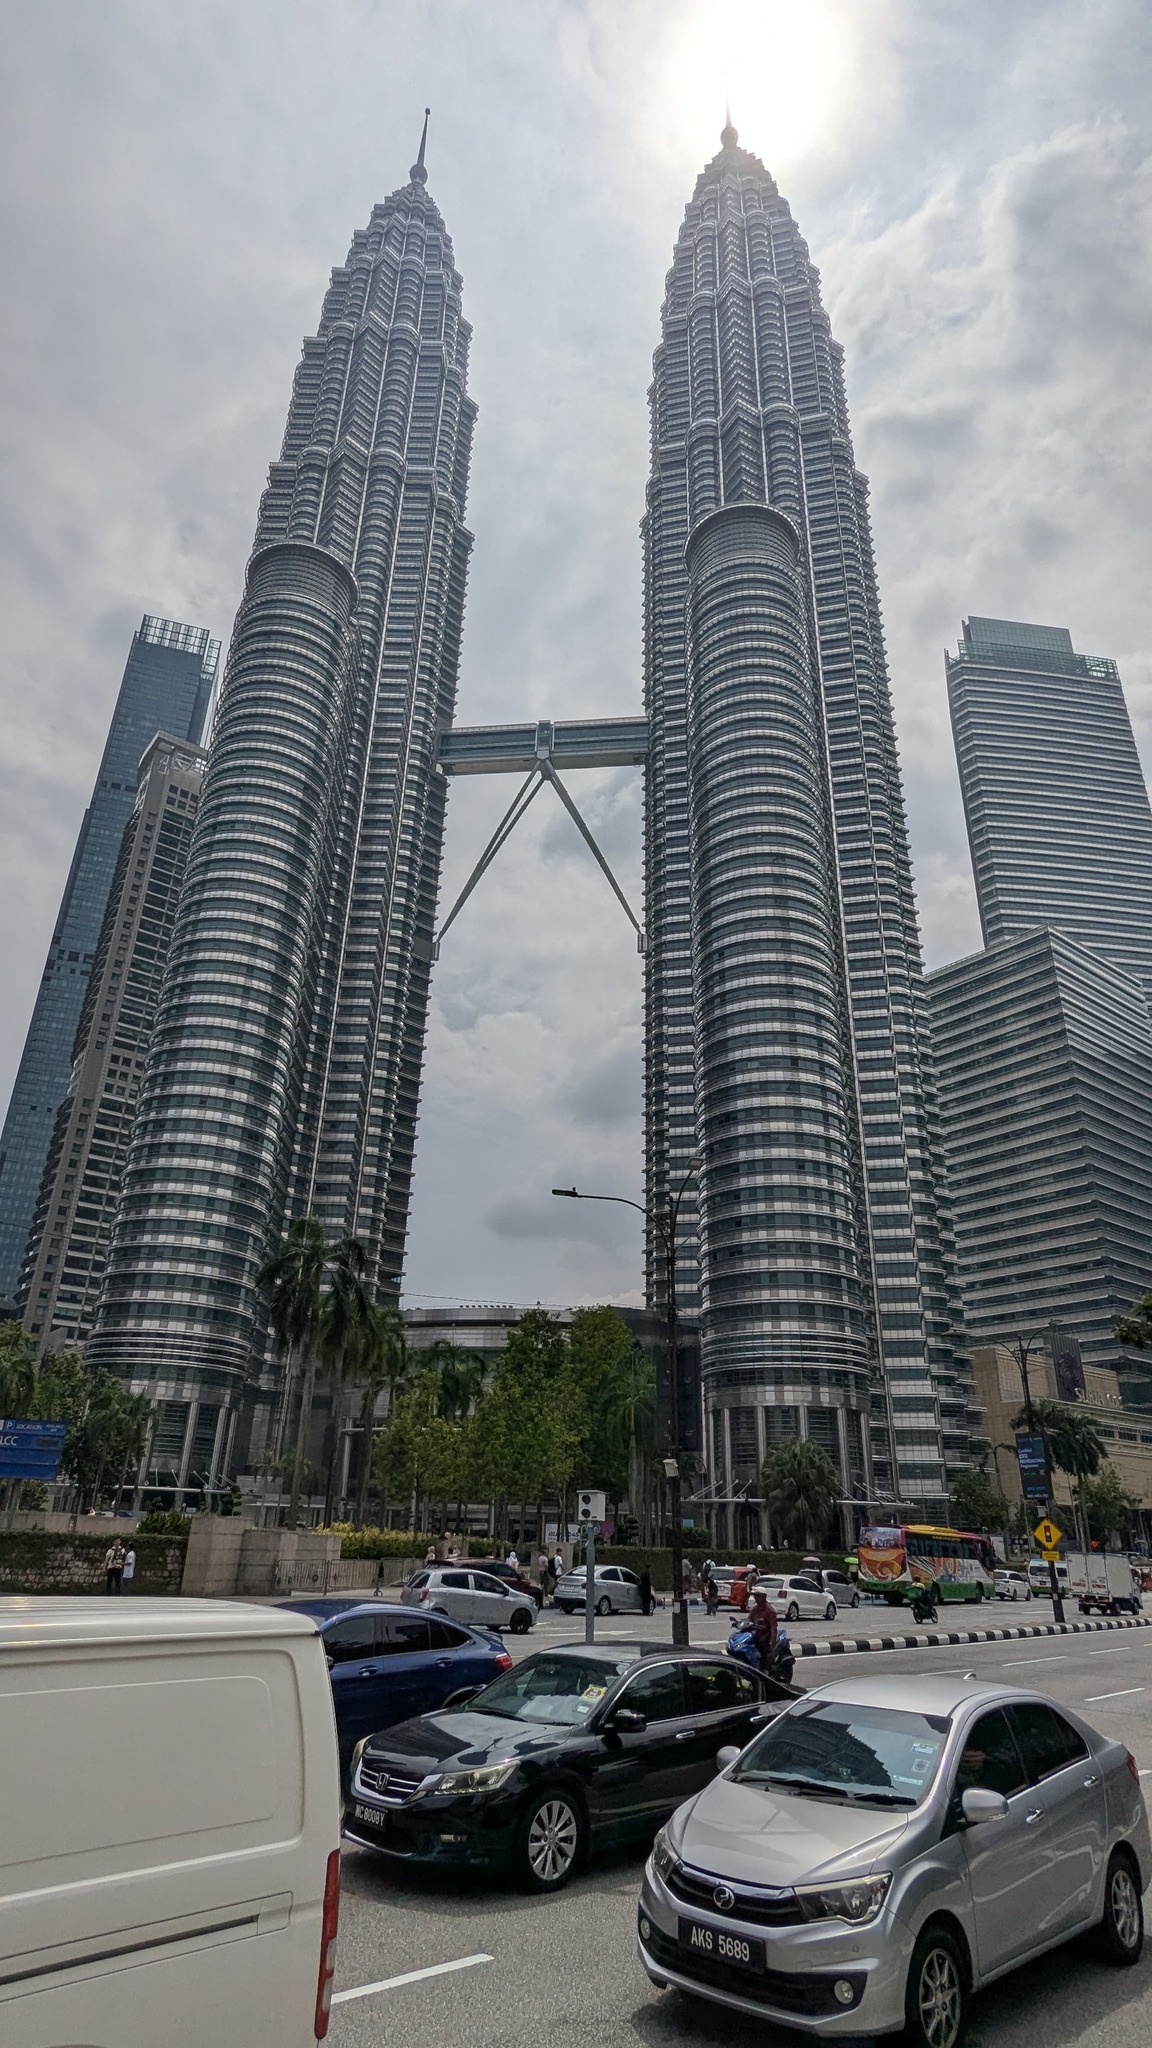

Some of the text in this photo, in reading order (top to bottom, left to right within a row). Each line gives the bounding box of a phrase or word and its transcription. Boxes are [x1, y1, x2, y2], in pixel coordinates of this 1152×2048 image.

[0, 1436, 18, 1445] LCC
[691, 1926, 750, 1962] AKS 5689
